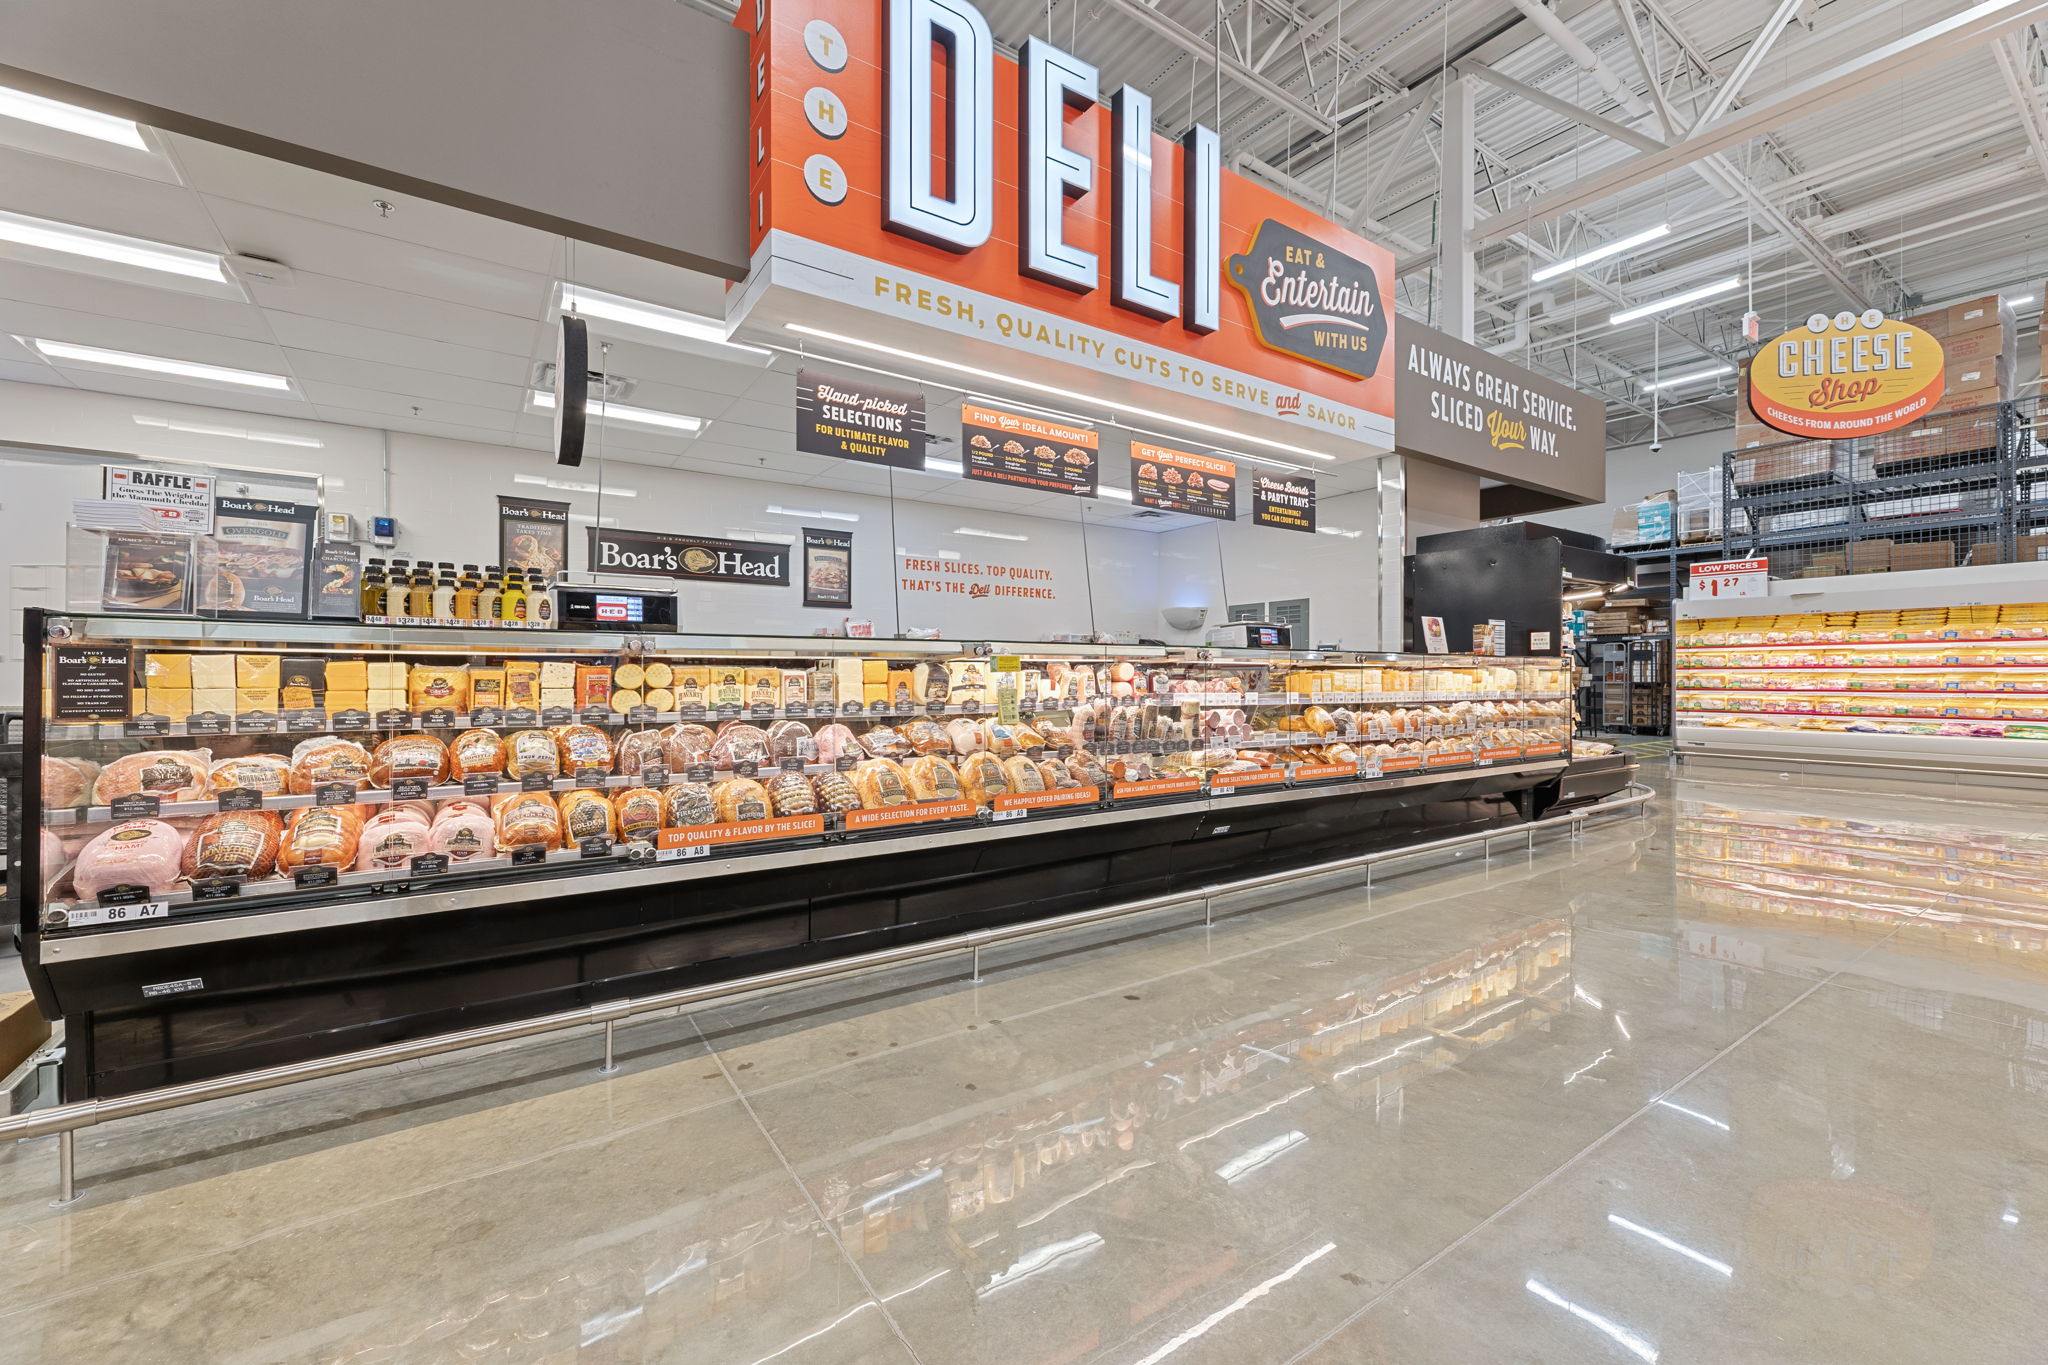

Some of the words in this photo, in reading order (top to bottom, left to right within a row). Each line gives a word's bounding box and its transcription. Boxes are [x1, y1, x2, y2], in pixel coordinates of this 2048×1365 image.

[881, 0, 1220, 336] DELI
[1286, 246, 1312, 265] EAT
[1315, 253, 1326, 269] &
[1261, 256, 1374, 317] Entertain
[1815, 313, 1876, 327] THE
[1314, 331, 1347, 350] WITH
[1351, 335, 1368, 352] US
[874, 276, 985, 329] FRESH,
[996, 313, 1105, 359] QUALITY
[1114, 347, 1171, 379] CUTS
[1179, 366, 1204, 385] TO
[1212, 375, 1269, 406] SERVE
[1275, 391, 1301, 411] and
[1307, 403, 1356, 431] SAVOR
[1778, 331, 1913, 378] CHEESE
[1408, 343, 1471, 392] ALWAYS
[1475, 370, 1519, 410] GREAT
[1522, 389, 1577, 432] SERVICE.
[1808, 377, 1883, 408] Shop
[817, 384, 908, 416] Hand-picked
[822, 404, 903, 432] SELECTIONS
[1767, 407, 1804, 426] CHEESES
[1805, 418, 1831, 429] FROM
[1833, 418, 1873, 429] AROUND
[1875, 412, 1893, 425] THE
[1894, 397, 1927, 418] WORLD
[974, 412, 997, 425] FIND
[998, 415, 1020, 429] Your
[1022, 423, 1048, 436] IDEAL
[1049, 428, 1089, 443] AMOUNT!
[1430, 391, 1484, 432] SLICED
[1487, 410, 1527, 447] Your
[1529, 425, 1559, 458] WAY.
[815, 423, 833, 435] FOR
[835, 427, 877, 443] ULTIMATE
[878, 435, 910, 449] FLAVOR
[841, 440, 848, 450] &
[850, 442, 887, 457] QUALITY
[1141, 447, 1155, 457] GET
[1175, 455, 1205, 468] PERFECT
[1205, 461, 1227, 472] SLICE!
[132, 471, 192, 490] RAFFLE
[1260, 477, 1284, 491] Cheese
[1284, 481, 1309, 496] Boards
[119, 486, 145, 495] Guess
[147, 488, 164, 497] The
[165, 490, 193, 501] Weight
[128, 493, 172, 505] Mammoth
[173, 497, 209, 508] Cheddar
[1261, 491, 1266, 500] &
[1267, 491, 1289, 505] PARTY
[1290, 495, 1309, 508] TRAYS
[222, 500, 252, 511] Boar's
[267, 504, 295, 515] Head
[502, 506, 529, 516] Boar's
[542, 511, 566, 520] Head
[225, 526, 286, 539] OVENGOLD
[806, 537, 825, 545] Boar's
[833, 539, 851, 547] Head
[600, 542, 678, 570] Boar's
[717, 552, 780, 579] Head
[905, 558, 940, 572] FRESH
[944, 561, 984, 575] SLICES.
[986, 565, 1006, 577] TOP
[1009, 567, 1053, 581] QUALITY.
[1698, 564, 1722, 573] LOW
[1723, 562, 1759, 571] PRICES
[902, 578, 941, 592] THAT'S
[945, 582, 965, 594] THE
[968, 583, 991, 595] Deli
[994, 585, 1056, 600] DIFFERENCE.
[1699, 580, 1706, 591] $
[1711, 579, 1718, 596] 1
[1723, 577, 1739, 586] 27
[253, 595, 274, 603] Boar's
[275, 596, 294, 604] Head
[59, 656, 87, 664] Boar's
[101, 656, 127, 664] Head
[1014, 797, 1036, 806] HAPPILY
[1037, 795, 1053, 803] OFFER
[1054, 793, 1074, 802] PAIRING
[1075, 791, 1091, 800] IDEAS!
[855, 815, 860, 823] A
[861, 813, 879, 823] WIDE
[880, 810, 915, 820] SELECTION
[929, 806, 949, 816] EVERY
[950, 803, 969, 812] TASTE.
[668, 833, 685, 843] TOP
[687, 829, 723, 842] QUALITY
[725, 828, 731, 837] &
[733, 825, 763, 836] FLAVOR
[765, 824, 775, 833] BY
[776, 822, 791, 832] THE
[792, 819, 816, 830] SLICE!
[676, 848, 686, 857] 86
[693, 846, 704, 856] A8
[108, 908, 126, 919] 86
[140, 905, 158, 917] A7
